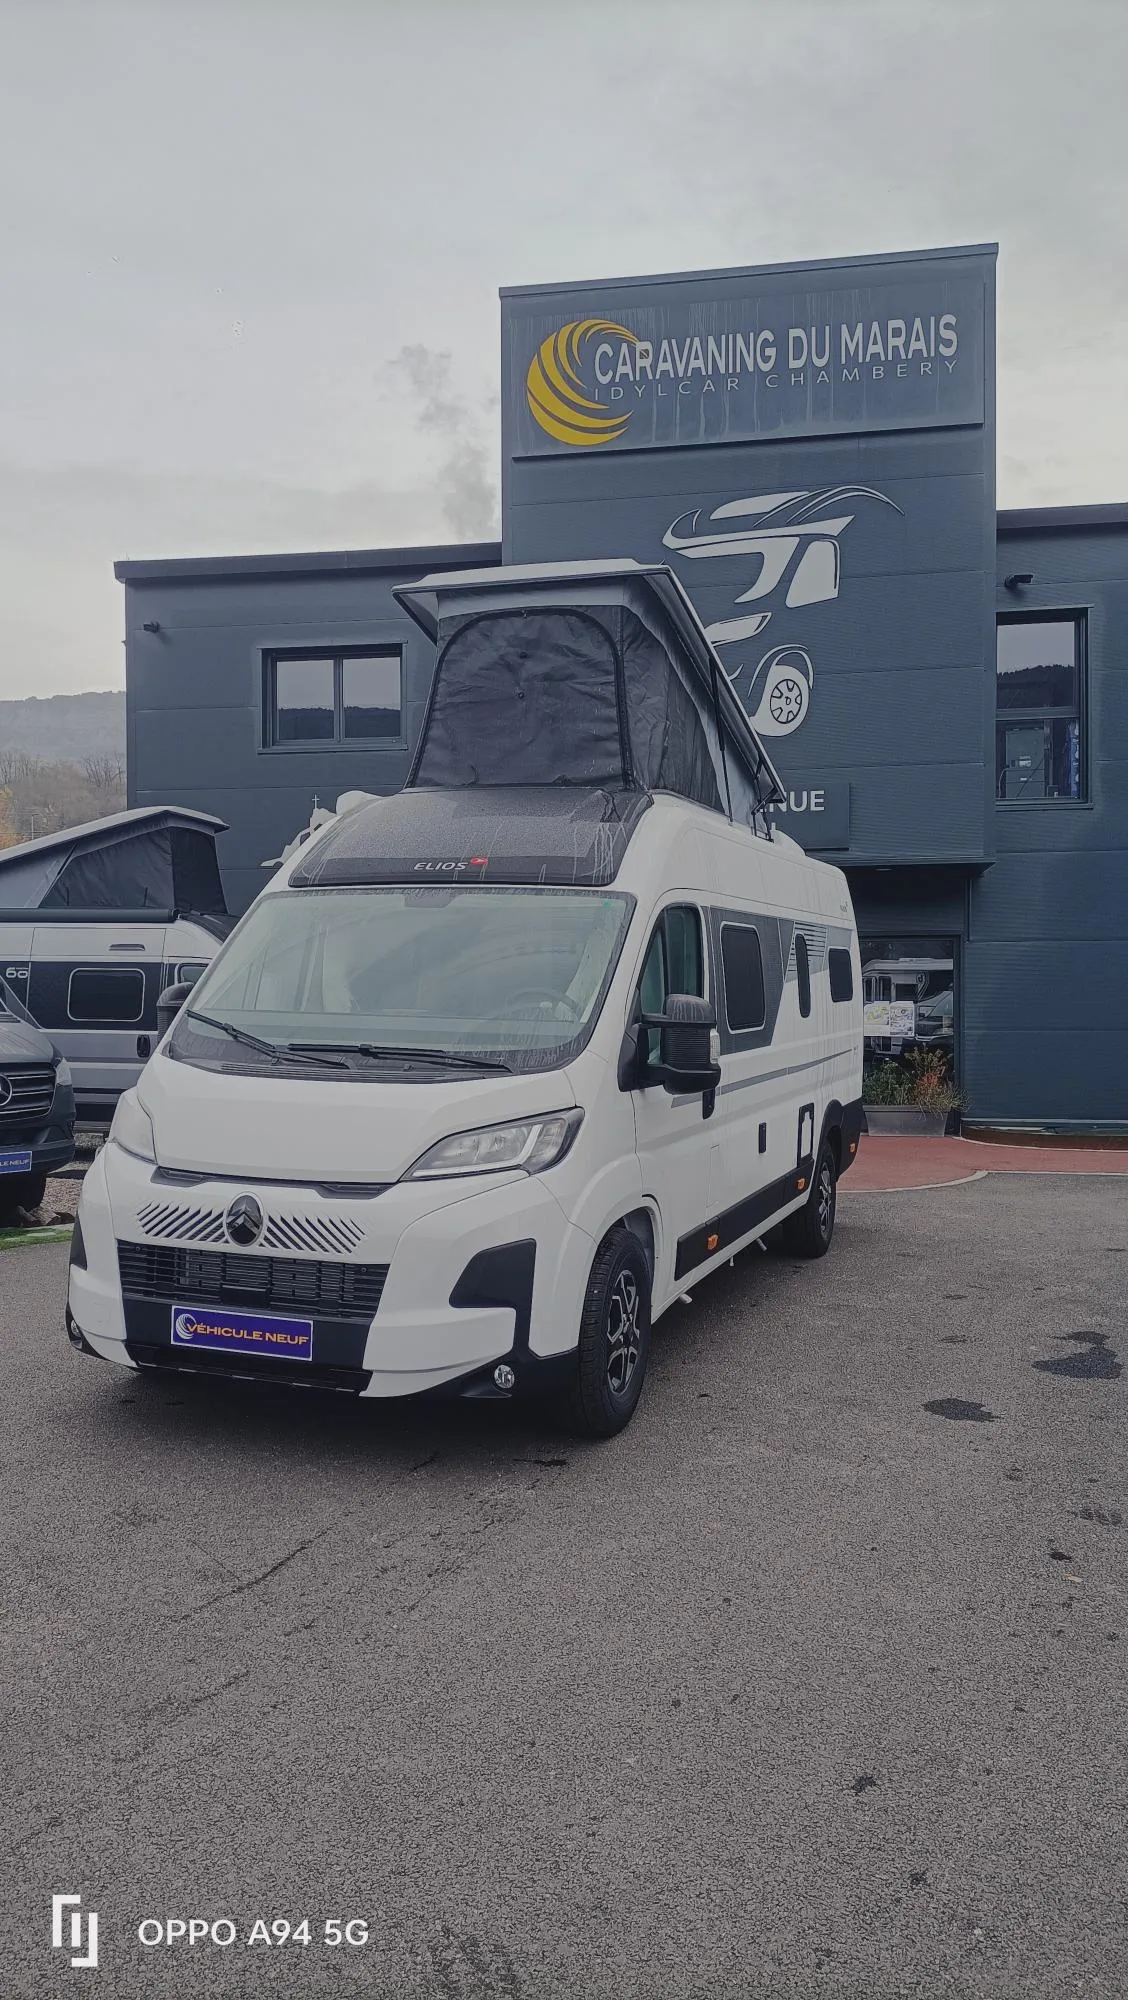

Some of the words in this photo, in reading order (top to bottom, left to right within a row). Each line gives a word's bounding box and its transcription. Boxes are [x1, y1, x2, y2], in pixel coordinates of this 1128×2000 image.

[594, 329, 777, 385] CARAVANING
[788, 325, 831, 370] DU
[840, 314, 958, 365] MARAIS
[594, 376, 739, 401] IDYLCAR
[765, 359, 958, 389] CHAMBERY
[759, 790, 825, 813] NUE
[413, 862, 469, 871] ELIOS
[186, 1322, 263, 1341] VÉHICULE
[265, 1333, 309, 1345] NEUF
